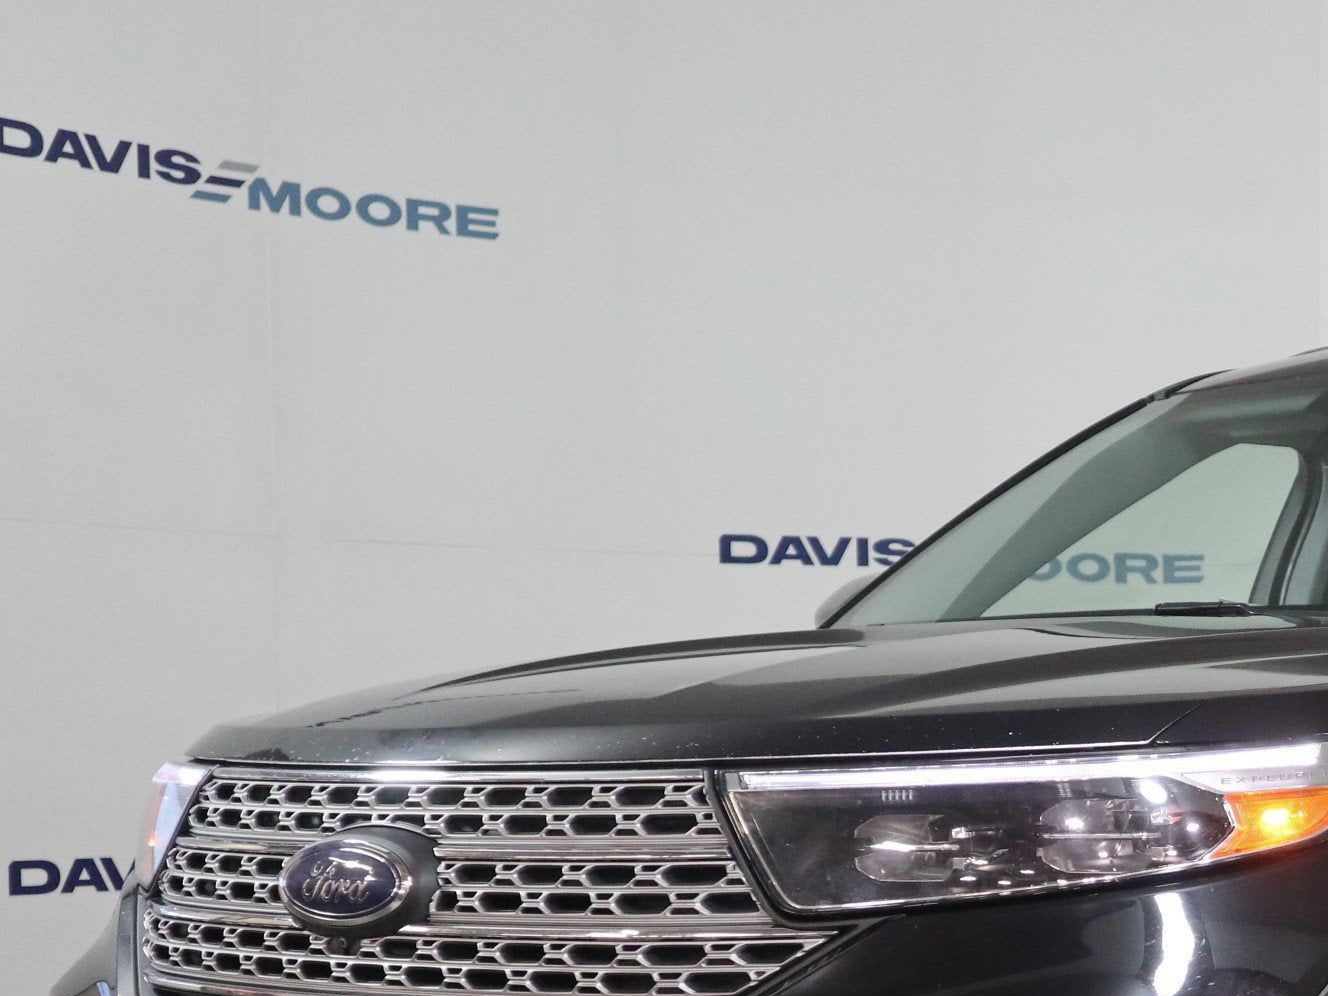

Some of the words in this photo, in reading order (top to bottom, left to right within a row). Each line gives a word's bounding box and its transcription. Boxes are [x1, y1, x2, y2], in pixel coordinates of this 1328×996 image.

[0, 116, 201, 185] DAVIS
[248, 176, 499, 240] MOORE
[719, 534, 917, 567] DAVIS
[301, 874, 370, 902] Ford
